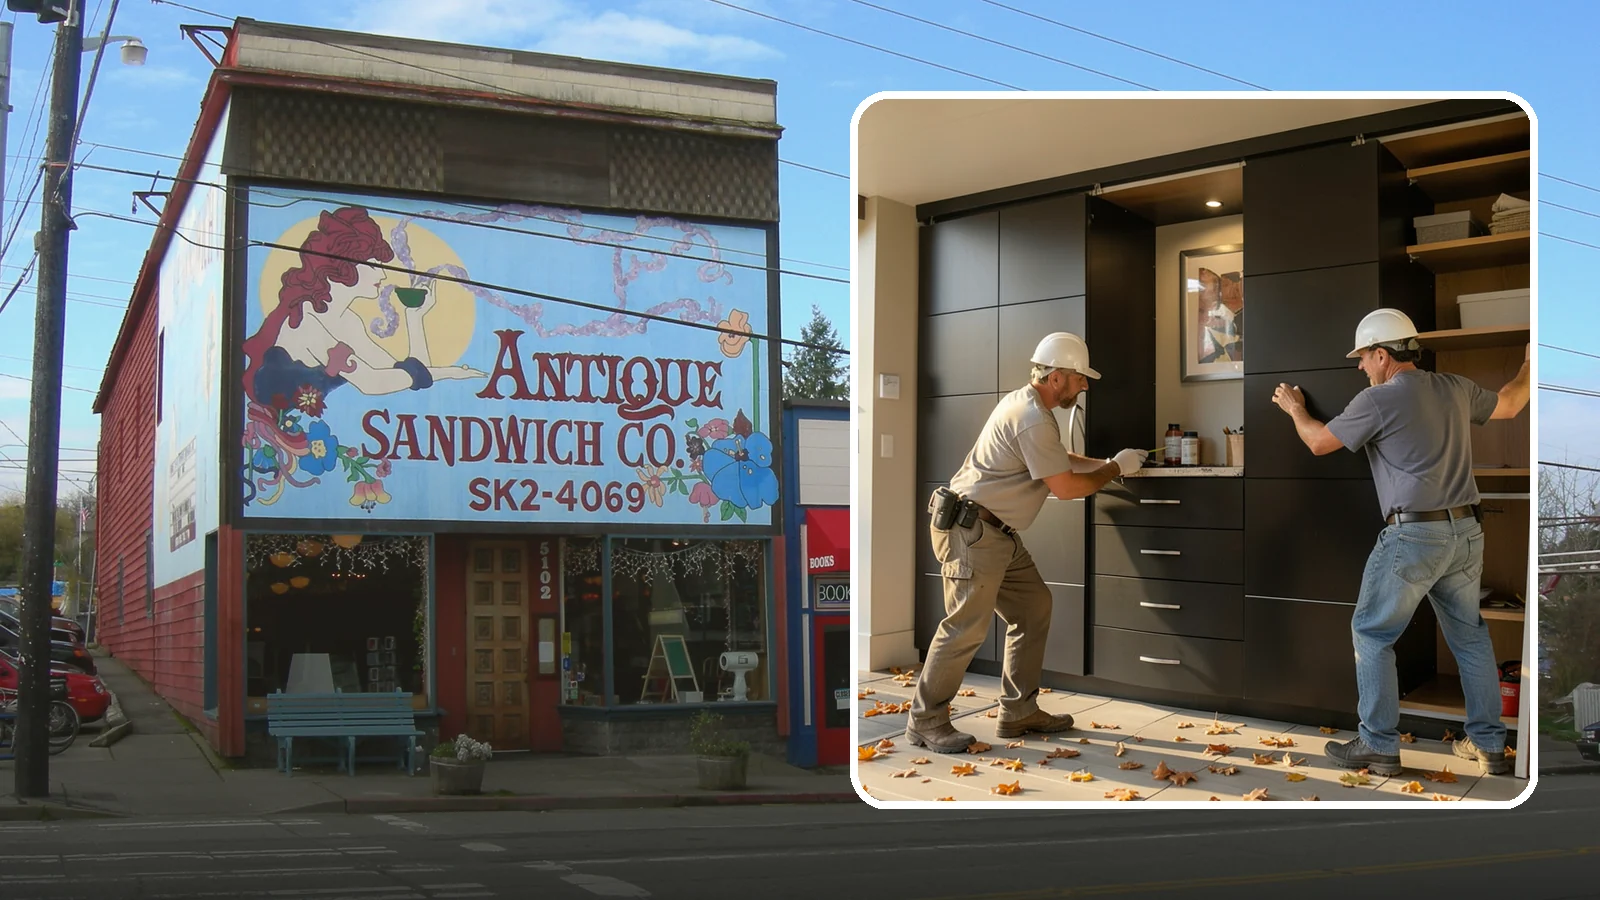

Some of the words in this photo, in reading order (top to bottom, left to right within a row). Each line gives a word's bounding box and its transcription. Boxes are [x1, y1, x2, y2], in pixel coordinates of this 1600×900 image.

[475, 328, 724, 420] ANTIQUE
[361, 408, 605, 467] SANDWICH
[616, 421, 685, 469] CO.
[468, 476, 646, 513] SK2-4069
[539, 541, 552, 600] 5102
[809, 555, 835, 569] BOOKS
